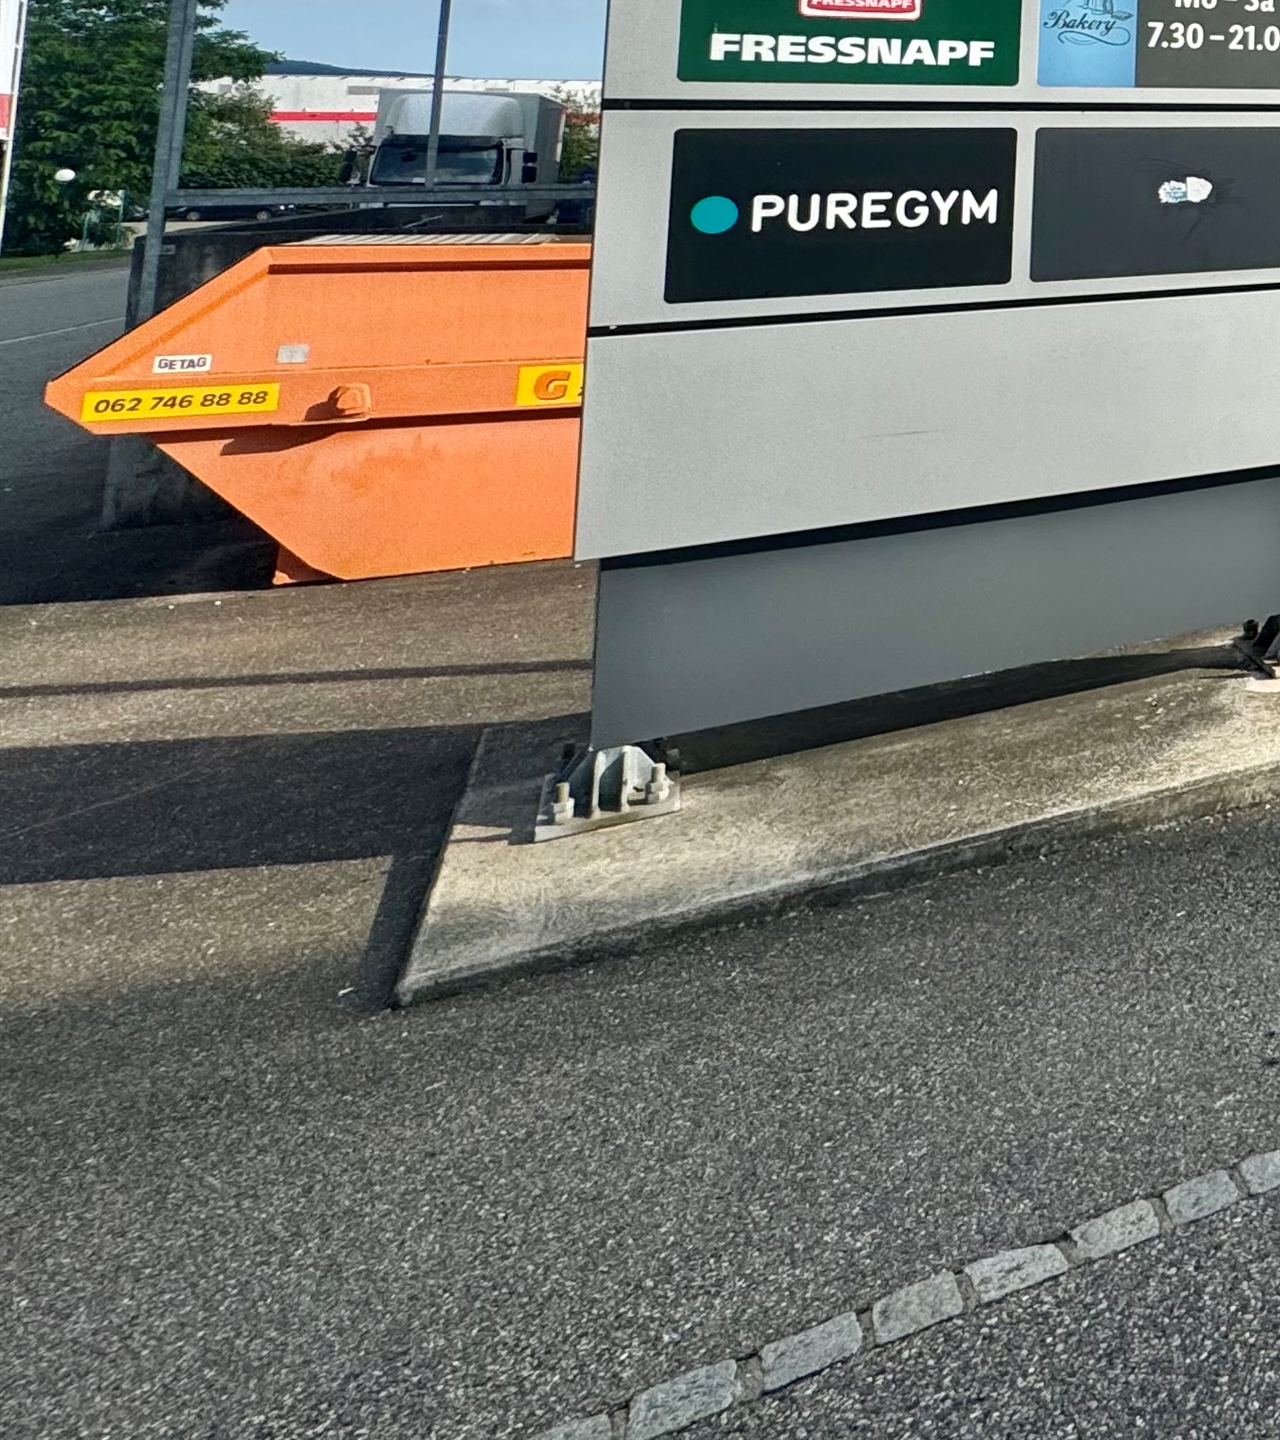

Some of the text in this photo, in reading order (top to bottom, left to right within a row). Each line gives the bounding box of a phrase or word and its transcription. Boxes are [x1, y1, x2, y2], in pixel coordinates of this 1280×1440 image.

[1043, 10, 1118, 36] Bakery
[709, 32, 995, 67] FRESSNAPF
[751, 188, 998, 233] PUREGYM
[157, 357, 207, 370] GETAG
[94, 390, 269, 414] 062 746 88 88
